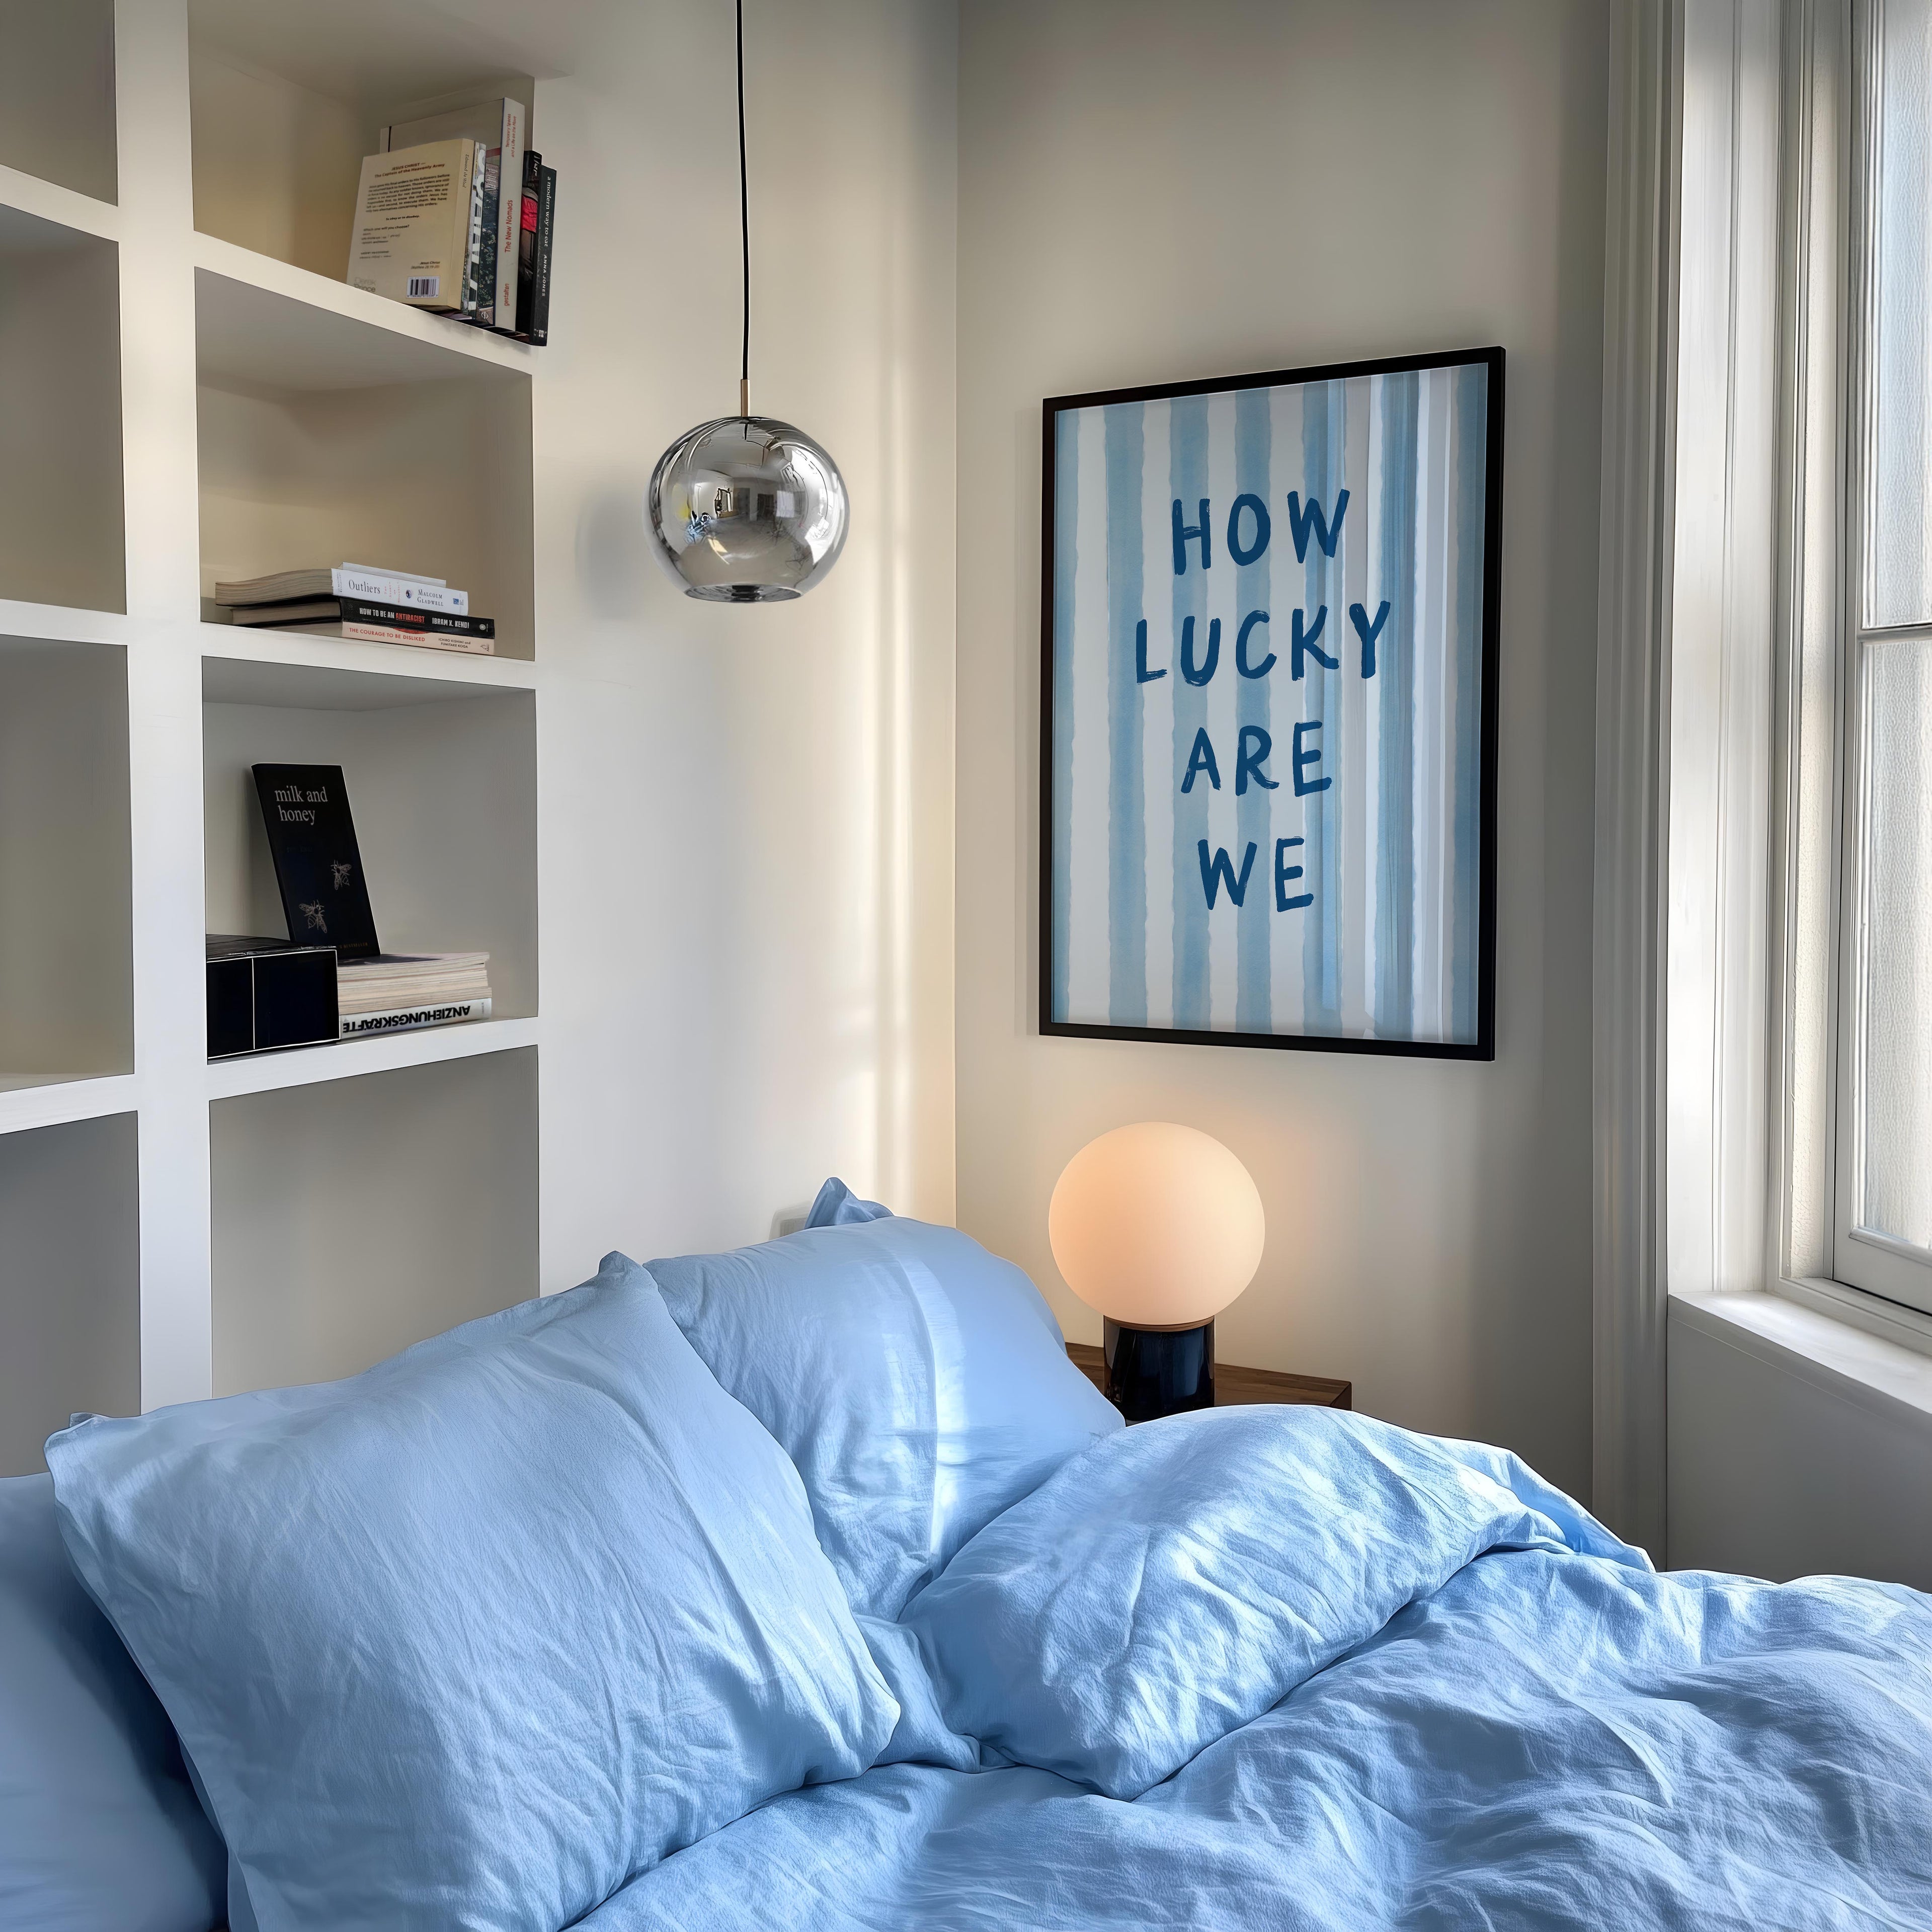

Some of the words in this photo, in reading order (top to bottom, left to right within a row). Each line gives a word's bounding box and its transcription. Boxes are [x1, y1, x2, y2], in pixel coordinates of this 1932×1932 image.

[1172, 489, 1350, 576] HOW
[349, 579, 380, 594] Outliers
[418, 589, 443, 599] MALCOLM
[417, 597, 444, 606] GLADWELL
[359, 607, 371, 616] HOW
[395, 612, 425, 623] ANTIRACIST
[432, 617, 448, 626] IBRAM
[455, 620, 469, 628] KENDI
[1136, 600, 1391, 687] LUCKY
[1180, 720, 1332, 797] ARE
[274, 784, 304, 803] milk
[306, 786, 328, 802] and
[277, 804, 316, 826] honey
[1197, 837, 1314, 913] WE
[343, 1005, 471, 1033] ANZIEHUNGSKRÄFTE
